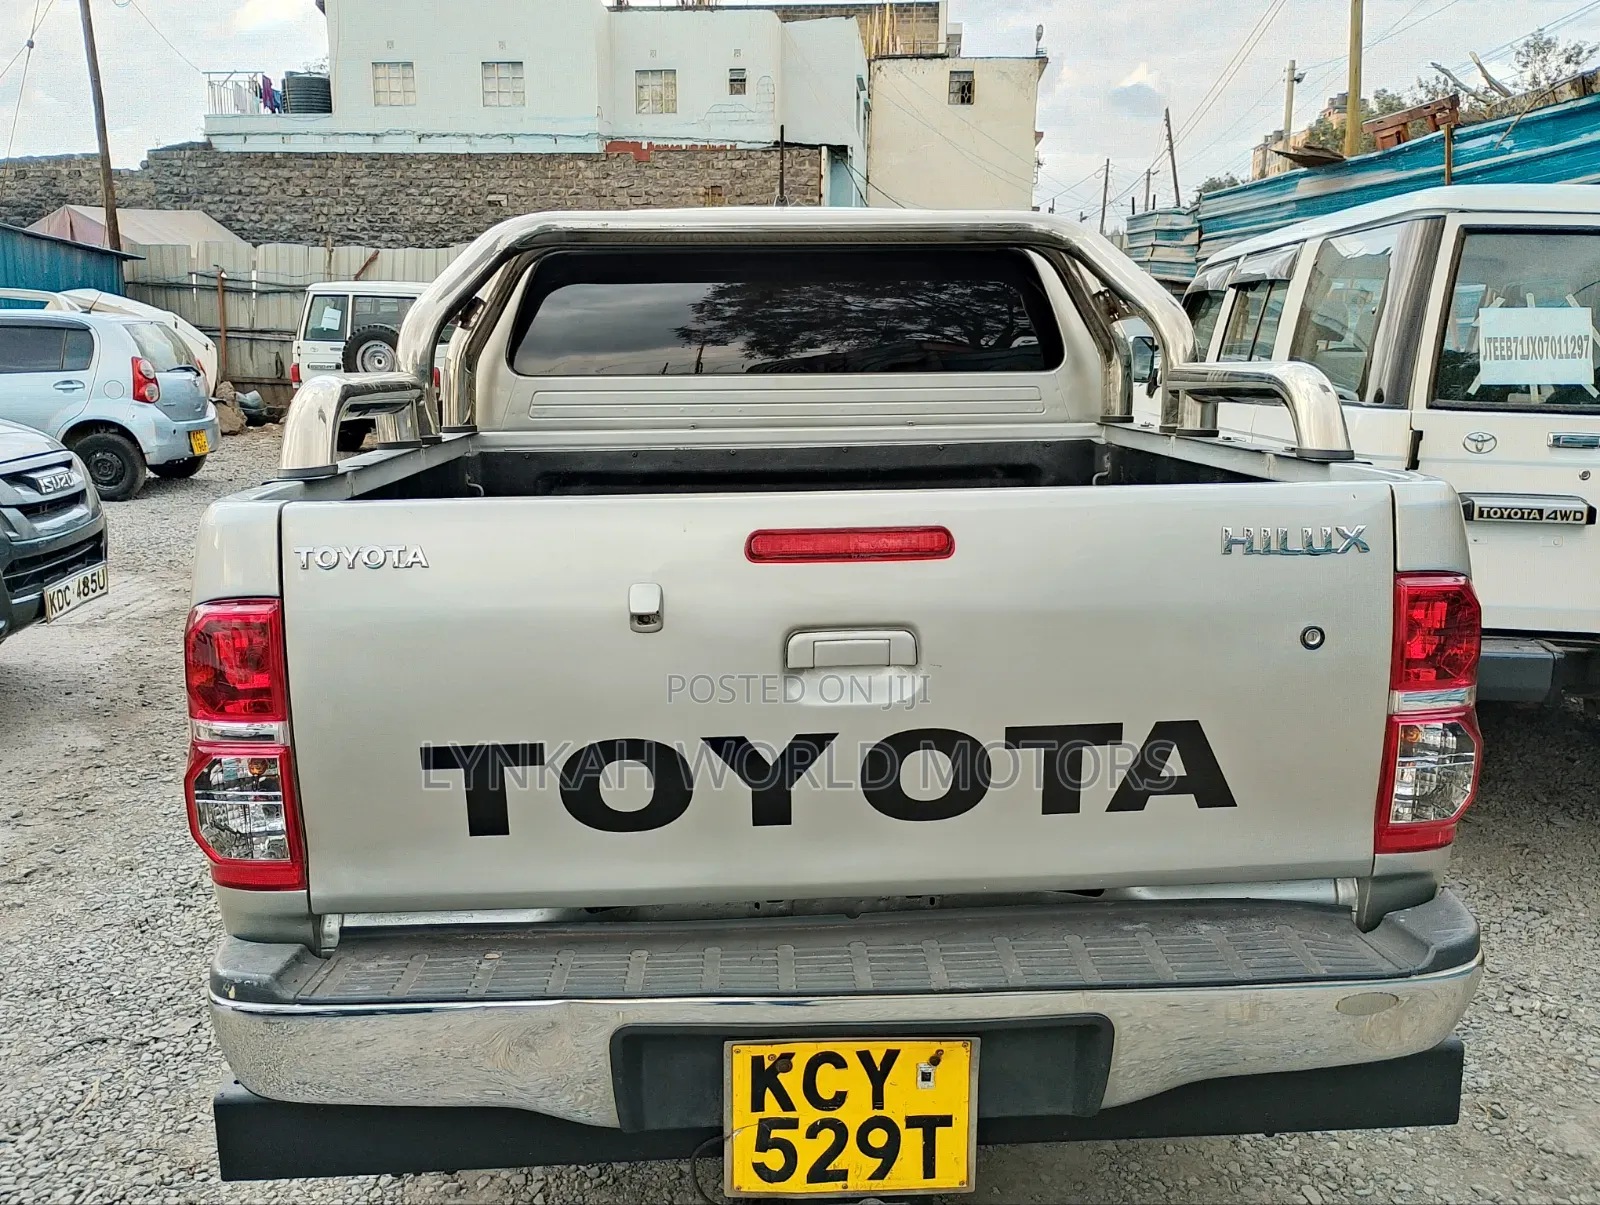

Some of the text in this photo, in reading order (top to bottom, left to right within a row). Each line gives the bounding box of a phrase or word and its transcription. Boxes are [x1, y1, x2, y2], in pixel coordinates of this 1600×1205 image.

[1483, 334, 1590, 361] JTEEB71JX07011297
[38, 470, 75, 494] ISUZU
[1481, 507, 1584, 521] TOYOTA 4WD
[1221, 524, 1371, 556] HILUX
[294, 545, 429, 570] TOYOTA
[48, 568, 106, 615] KDC 485U
[419, 719, 1237, 837] TOYOTA
[750, 1048, 901, 1113] KCY
[751, 1114, 953, 1184] 529T
